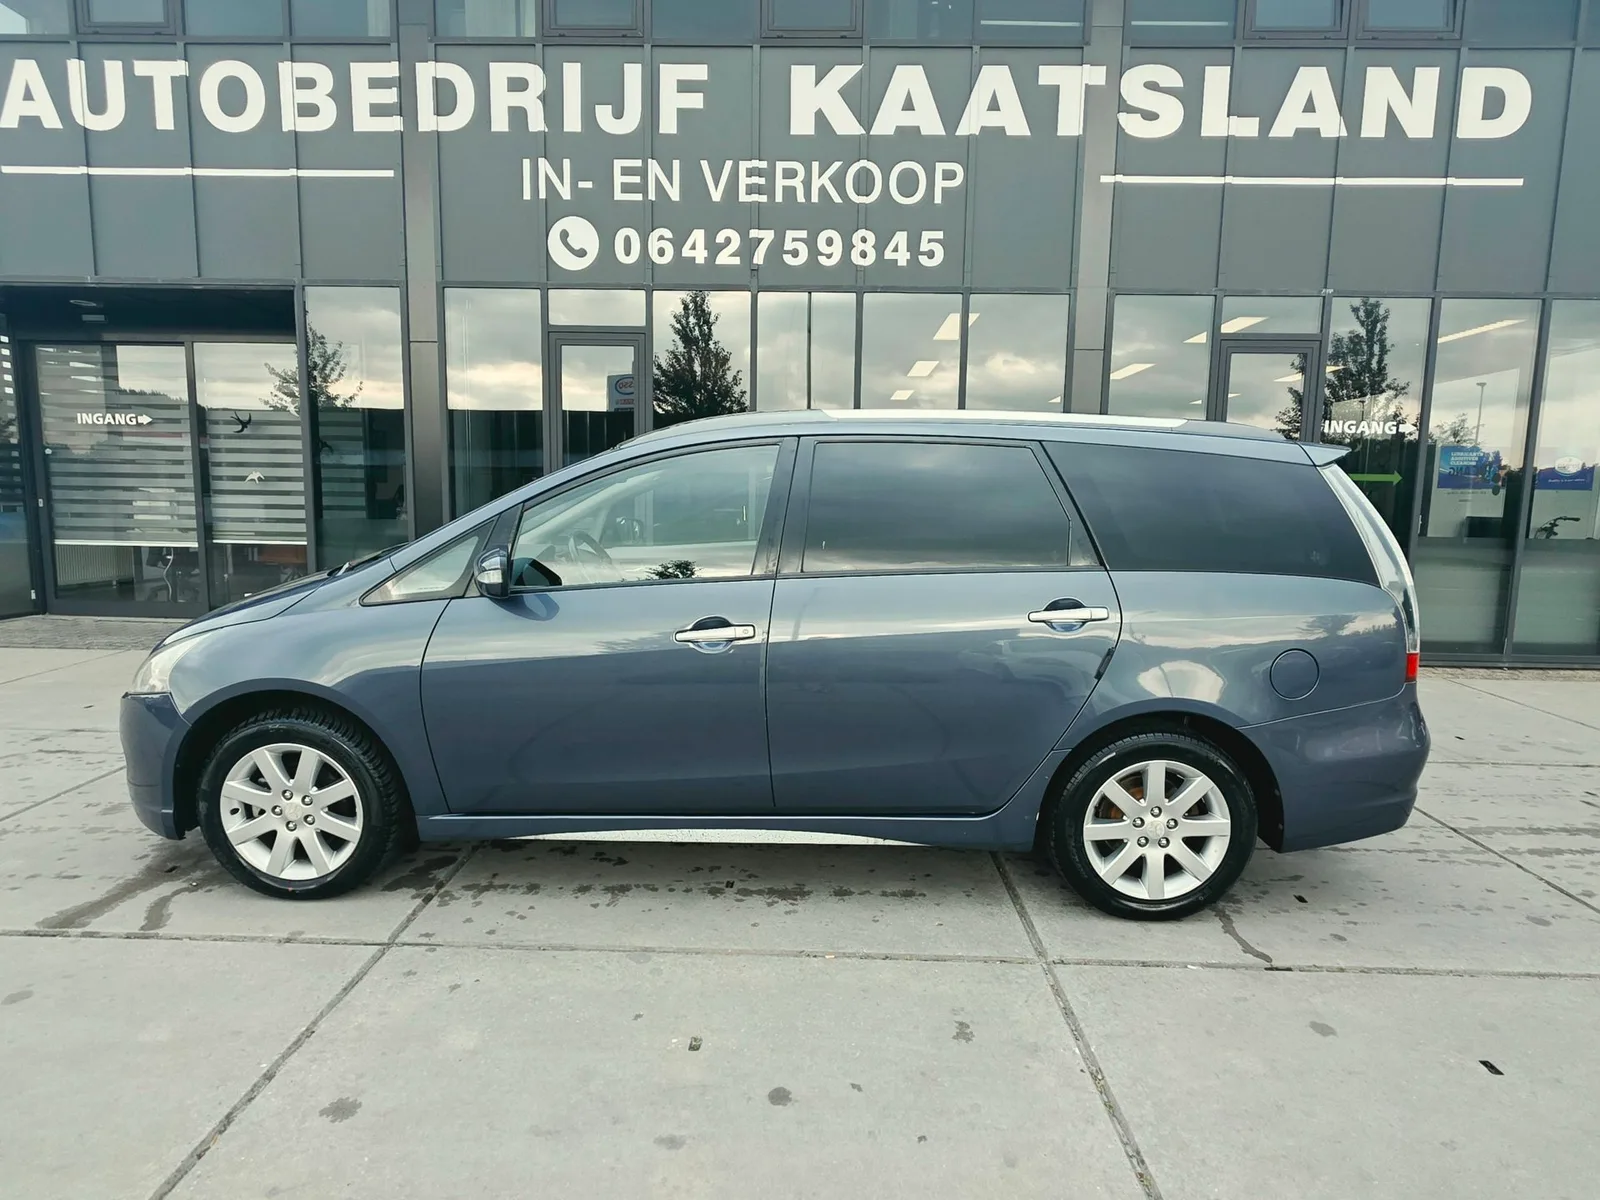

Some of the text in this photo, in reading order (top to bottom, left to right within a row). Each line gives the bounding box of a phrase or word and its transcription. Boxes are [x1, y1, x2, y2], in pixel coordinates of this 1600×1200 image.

[0, 58, 1533, 140] AUTOBEDRIJF KAATSLAND
[521, 157, 965, 205] IN- EN VERKOOP
[613, 227, 946, 268] 0642759845
[76, 412, 137, 425] INGANG
[1323, 419, 1397, 435] INGANG
